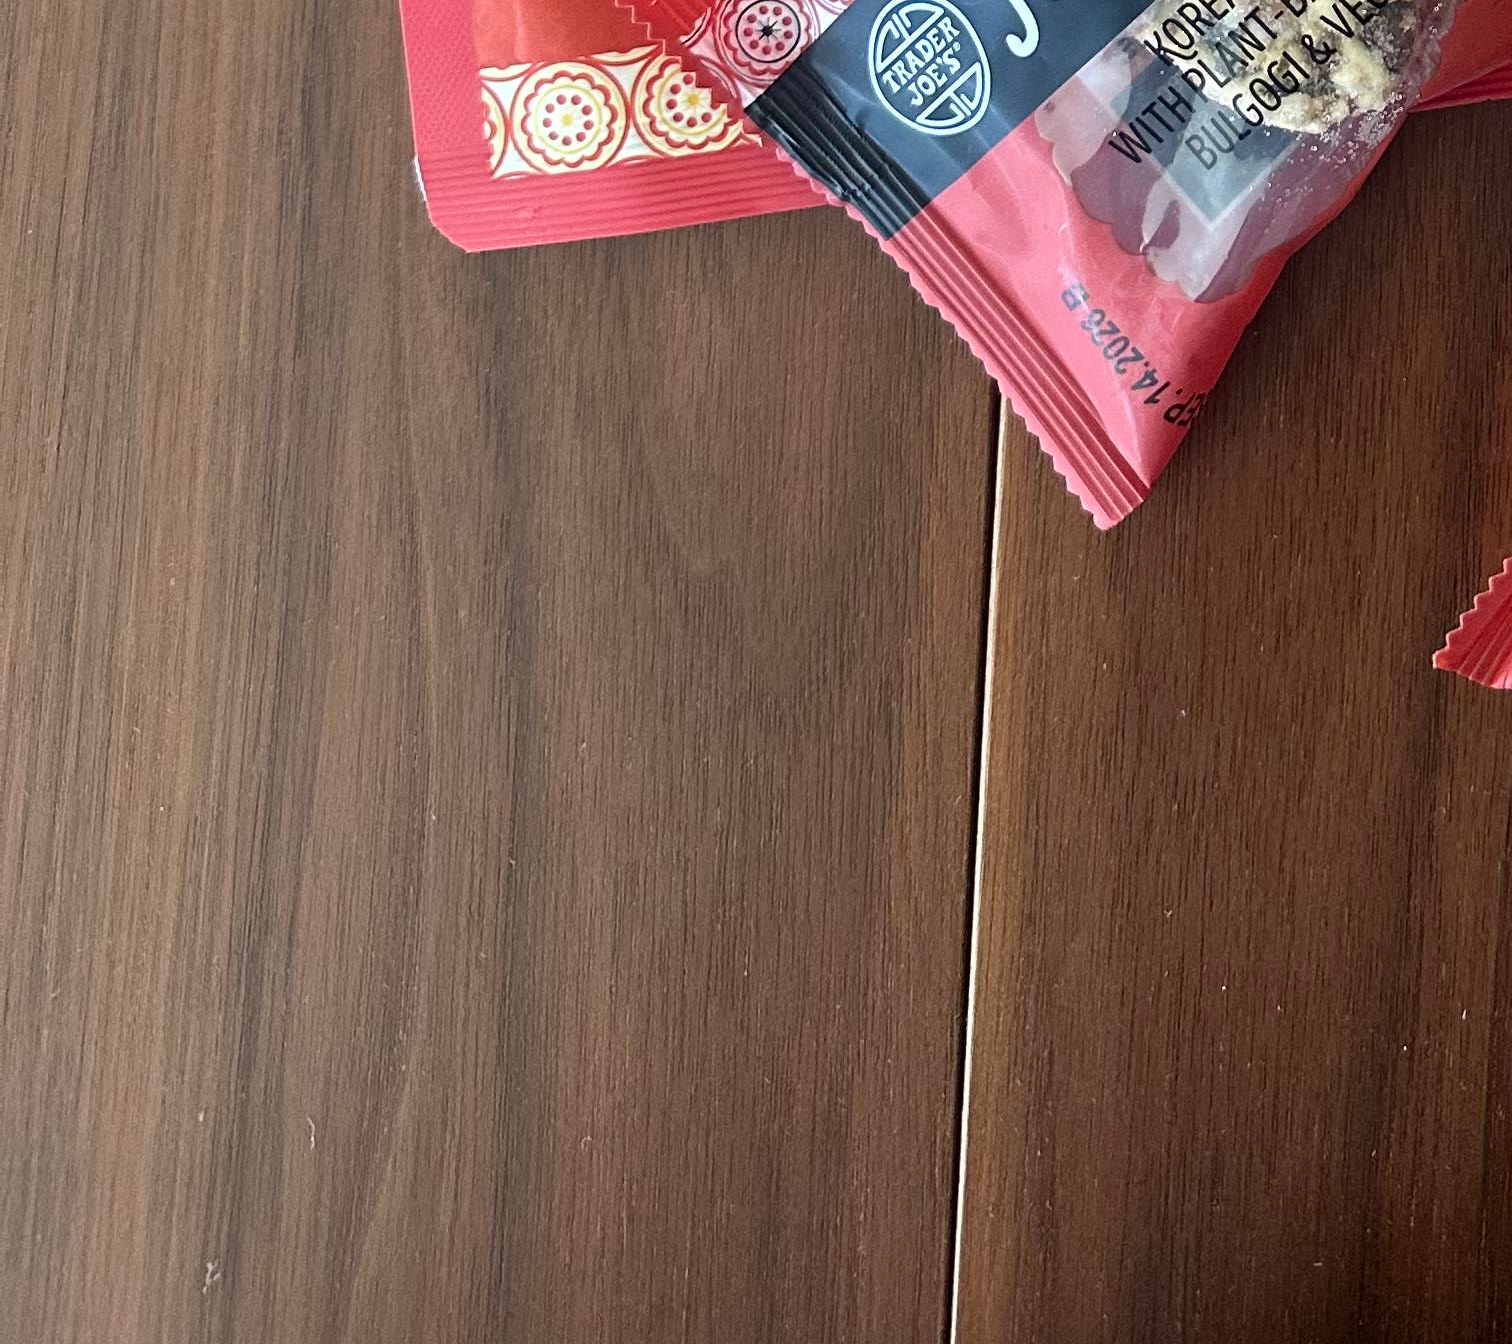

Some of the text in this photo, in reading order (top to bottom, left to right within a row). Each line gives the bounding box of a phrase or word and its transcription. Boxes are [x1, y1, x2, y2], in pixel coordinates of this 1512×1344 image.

[883, 18, 957, 95] TRADER
[1110, 90, 1191, 165] WITH
[1183, 53, 1303, 171] BULGOGI
[1305, 36, 1336, 64] &
